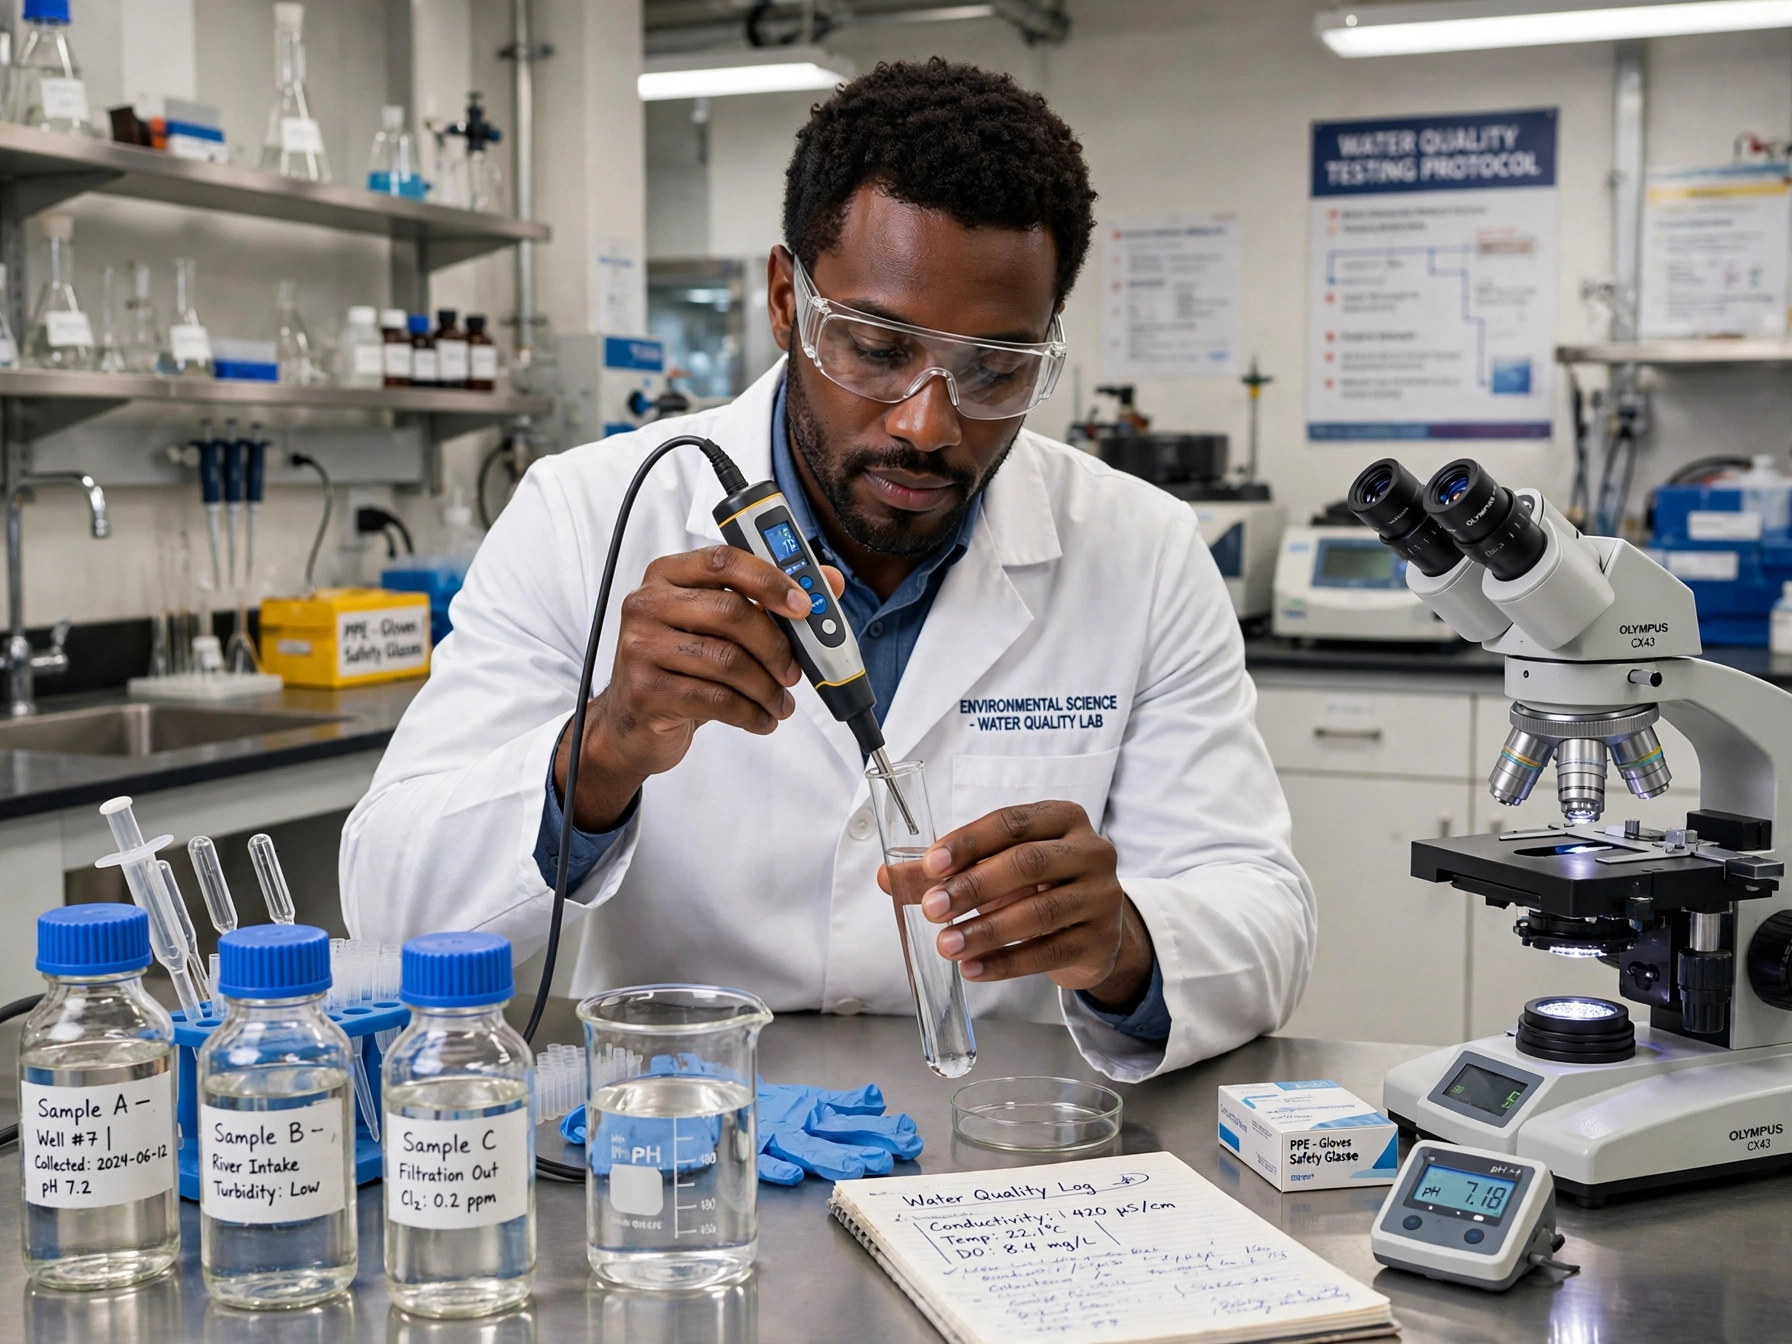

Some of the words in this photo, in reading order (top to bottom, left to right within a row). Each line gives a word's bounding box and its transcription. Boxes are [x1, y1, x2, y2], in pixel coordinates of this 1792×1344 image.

[1337, 128, 1417, 158] WATER
[1419, 125, 1520, 154] QUALITY
[1325, 157, 1417, 185] TESTING
[1420, 151, 1541, 182] PROTOCOL
[1619, 622, 1669, 635] OLYMPUS
[1631, 637, 1656, 648] CX43
[960, 697, 1063, 714] ENVIRONMENTAL
[1066, 695, 1117, 711] SCIENCE
[978, 716, 1021, 731] WATER
[1024, 715, 1076, 731] QUALITY
[1079, 714, 1104, 729] LAB
[38, 1098, 102, 1126] Sample
[113, 1093, 128, 1116] A
[36, 1129, 64, 1147] Well
[71, 1131, 98, 1147] #7
[214, 1122, 277, 1152] Sample
[289, 1121, 304, 1143] B
[1729, 1123, 1783, 1141] OLYMPUS
[403, 1131, 471, 1162] Sample
[482, 1129, 497, 1150] C
[1290, 1139, 1310, 1151] PPE
[1319, 1137, 1352, 1148] Gloves
[1747, 1138, 1771, 1151] CX43
[34, 1155, 91, 1172] Collected:
[96, 1144, 168, 1171] 2024-06-12
[212, 1153, 242, 1173] River
[249, 1157, 300, 1174] Intake
[1289, 1152, 1322, 1166] Safety
[399, 1162, 464, 1182] Filtration
[472, 1161, 499, 1180] Out
[42, 1179, 57, 1198] pH
[65, 1180, 92, 1195] 7.2
[213, 1180, 282, 1207] Turbidity:
[290, 1181, 320, 1197] Low
[902, 1194, 963, 1207] Water
[974, 1185, 1046, 1200] Quality
[1058, 1182, 1096, 1195] Log
[1421, 1185, 1441, 1198] pH
[1465, 1181, 1507, 1209] 7.18
[433, 1193, 460, 1208] 0.2
[467, 1193, 497, 1213] ppm
[930, 1212, 1053, 1231] Conductivity:
[1072, 1207, 1106, 1218] 420
[940, 1232, 999, 1246] Temp:
[1005, 1224, 1066, 1239] 22.1°C
[956, 1247, 996, 1259] DO:
[1003, 1242, 1036, 1255] 8.4
[1047, 1235, 1096, 1251] mg/L
